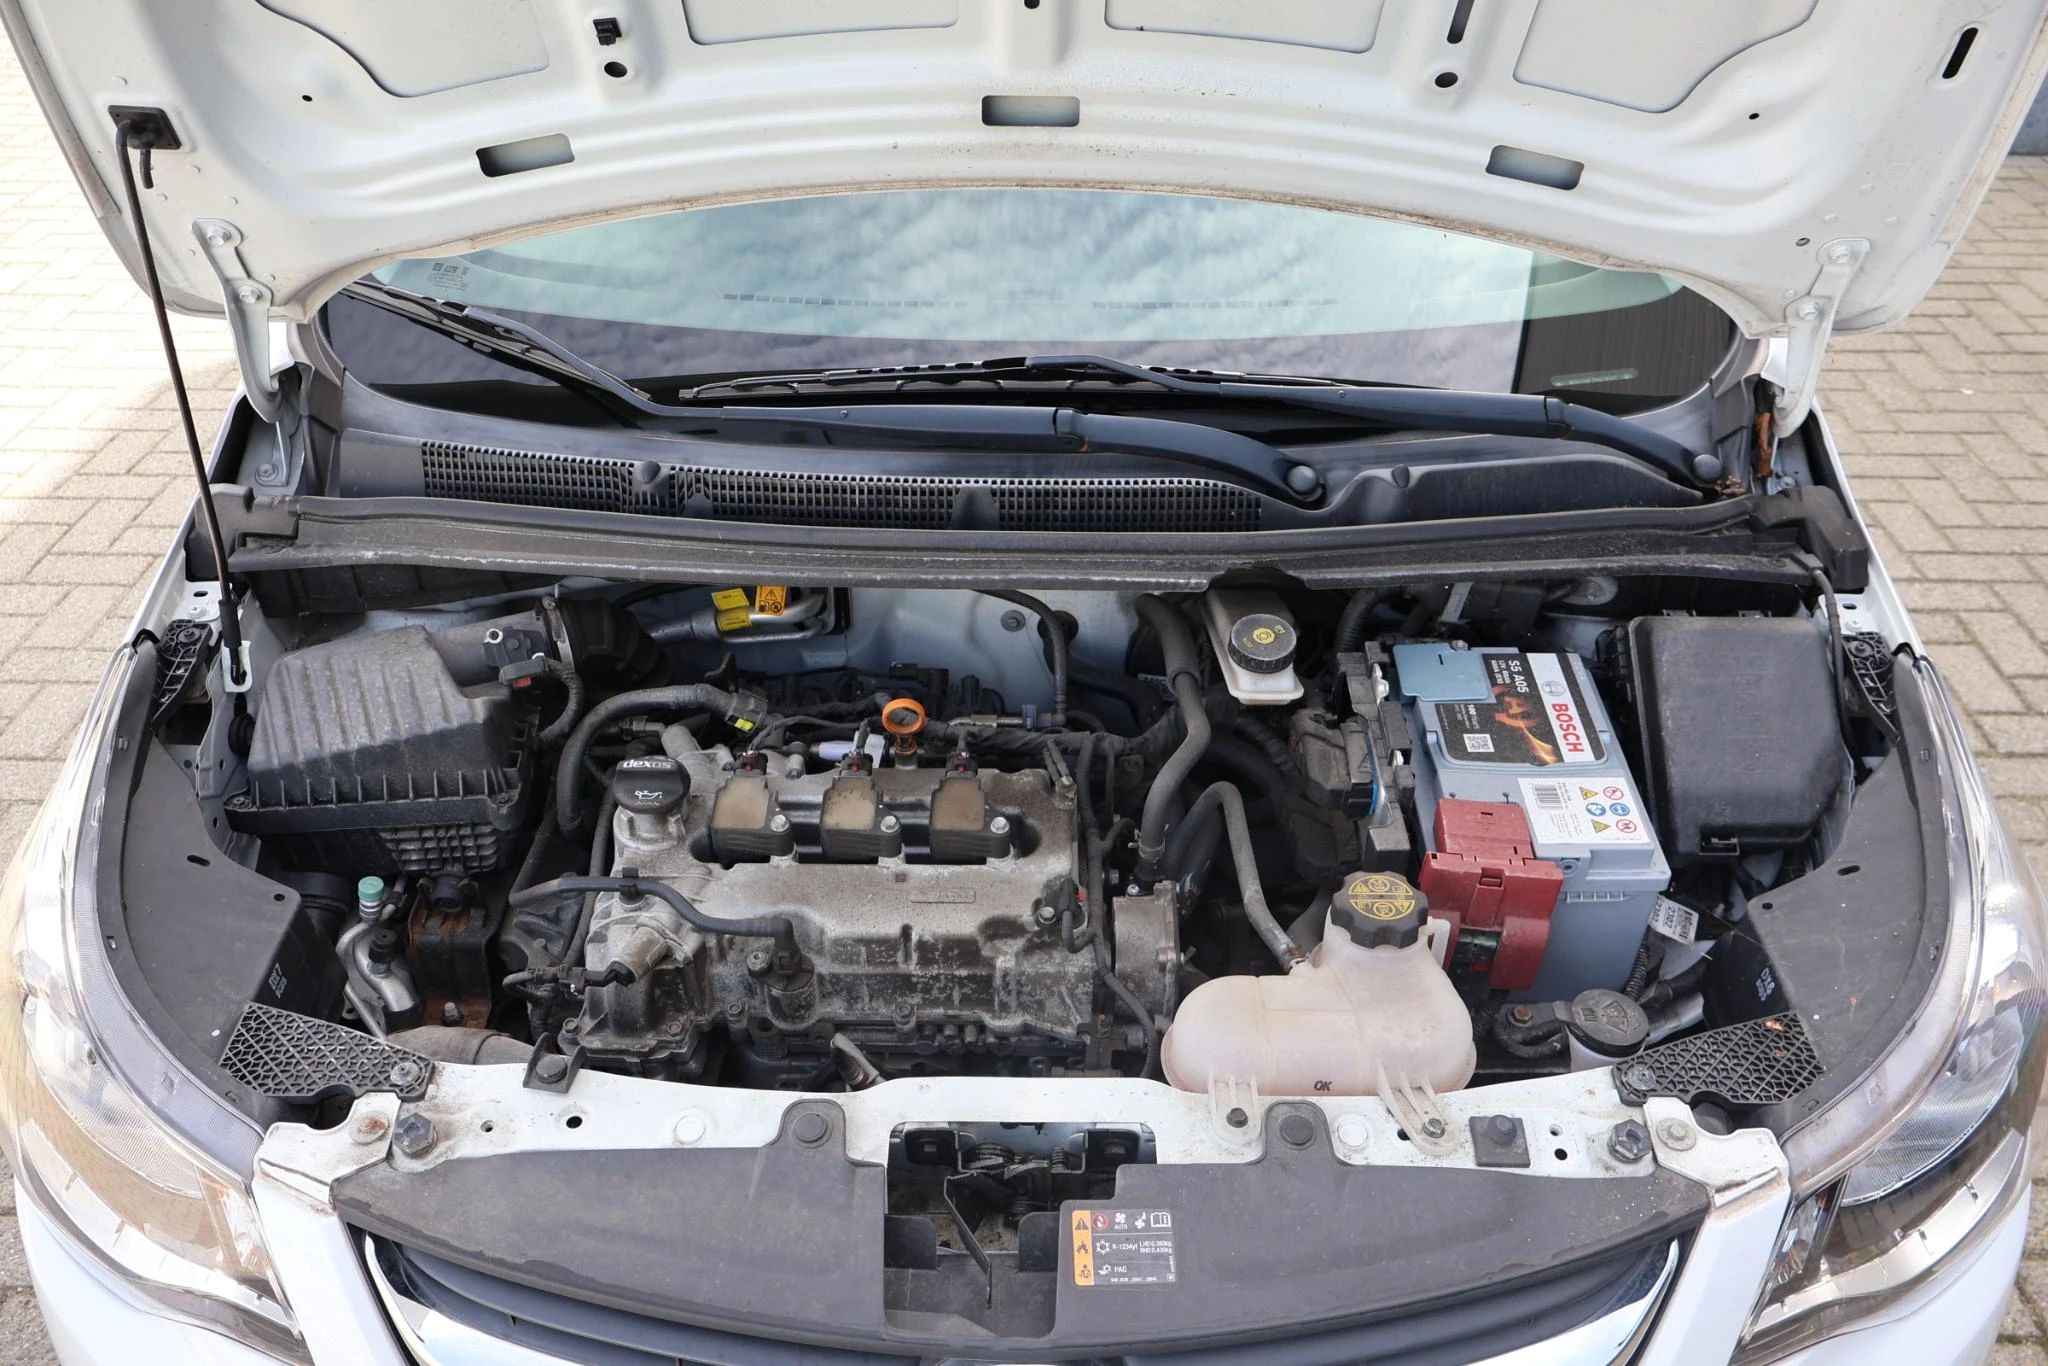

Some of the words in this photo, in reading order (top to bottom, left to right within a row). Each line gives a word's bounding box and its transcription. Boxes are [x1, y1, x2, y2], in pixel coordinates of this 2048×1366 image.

[1508, 660, 1522, 672] S5
[1512, 674, 1529, 693] A05
[1552, 703, 1585, 753] BOSCH
[623, 760, 675, 769] dexos
[1665, 906, 1676, 928] 2302
[1314, 1080, 1332, 1092] OK
